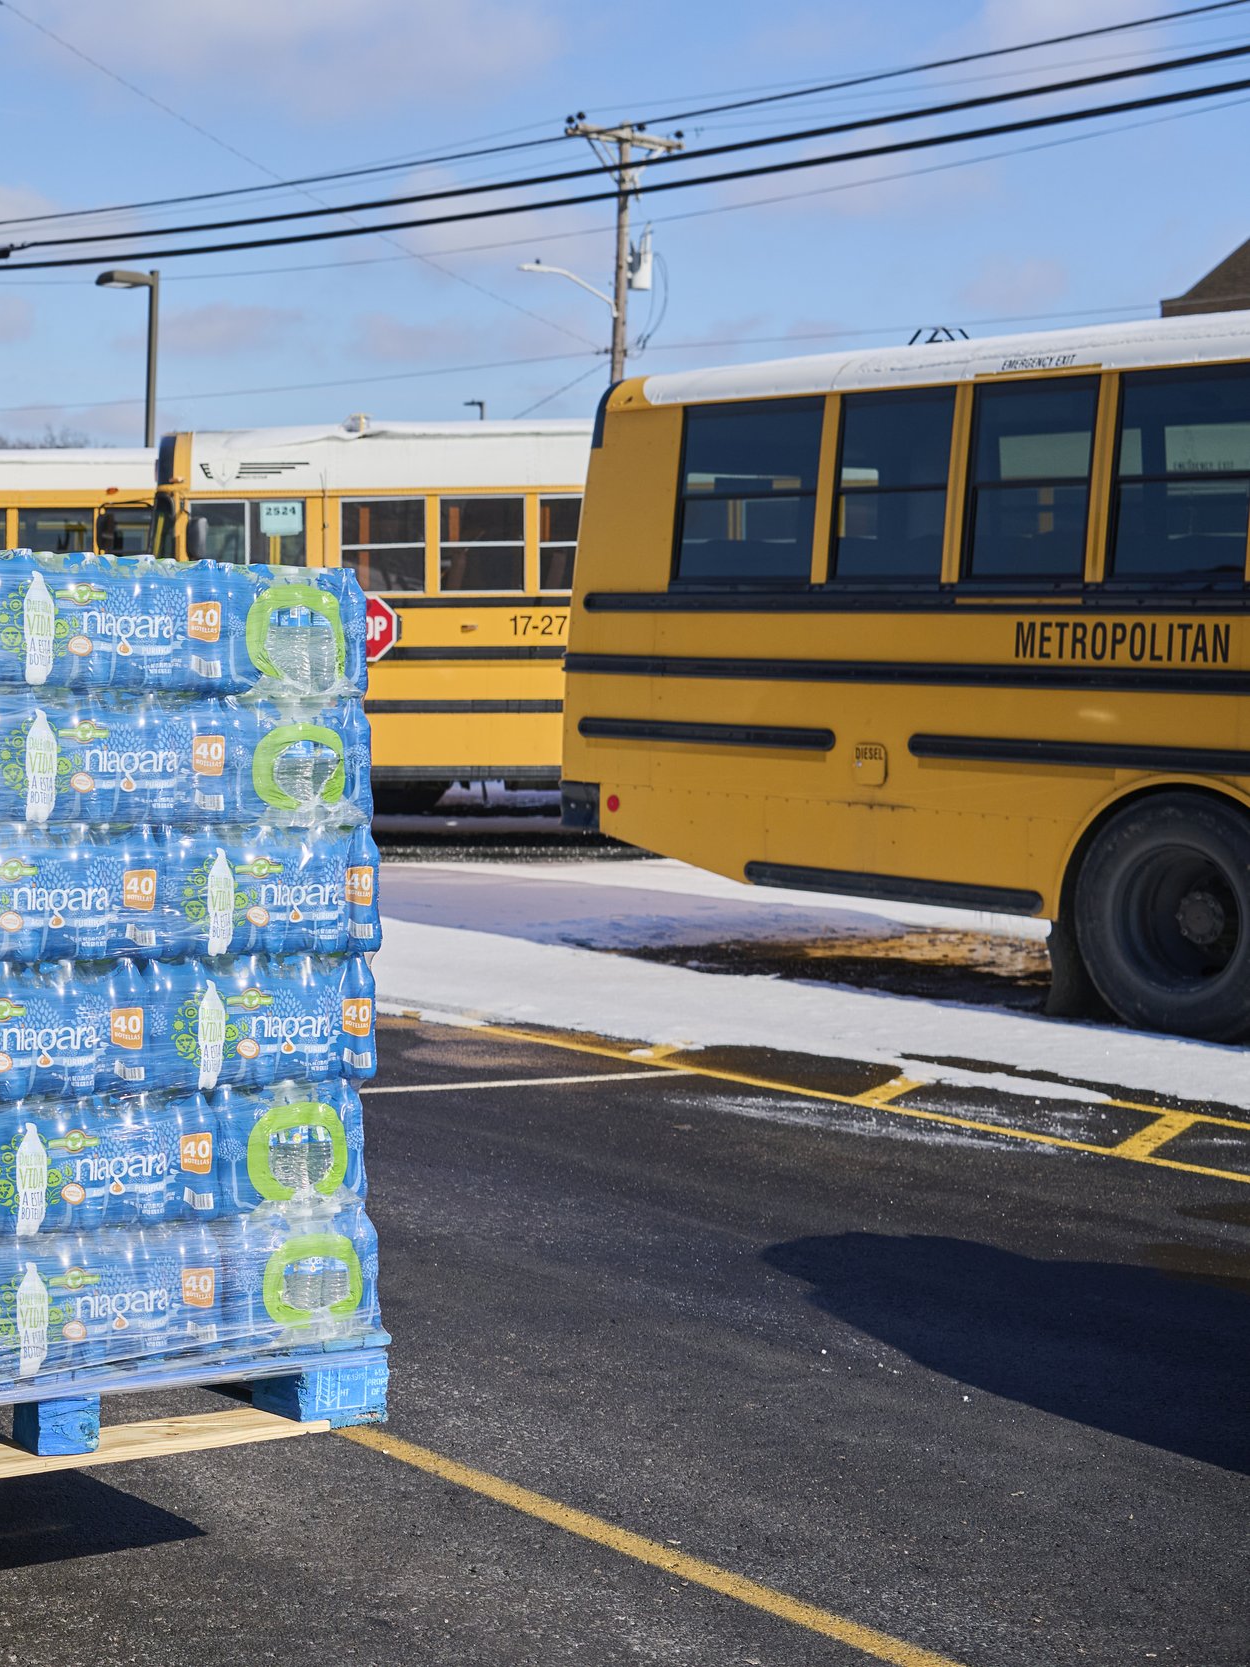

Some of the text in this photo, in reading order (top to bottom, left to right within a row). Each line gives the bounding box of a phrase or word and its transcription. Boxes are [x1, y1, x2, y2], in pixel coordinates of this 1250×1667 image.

[1001, 354, 1077, 370] EMERGENCY EXIT
[265, 506, 297, 516] 2524
[26, 614, 52, 636] VIDA
[191, 609, 219, 626] 40
[510, 615, 568, 635] 17-27
[82, 608, 174, 650] niagara
[366, 616, 388, 640] OP
[30, 637, 36, 652] A
[1014, 621, 1231, 663] METROPOLITAN
[195, 743, 223, 760] 40
[855, 747, 884, 760] DIESEL
[28, 752, 54, 774] VIDA
[85, 744, 178, 785] niagara
[32, 776, 38, 789] A
[126, 877, 153, 895] 40
[347, 873, 371, 890] 40
[13, 882, 110, 922] niagara
[213, 912, 219, 926] A
[345, 1005, 369, 1022] 40
[114, 1015, 141, 1034] 40
[200, 1022, 223, 1042] VIDA
[2, 1023, 97, 1061] niagara
[114, 1032, 140, 1041] BOTELLAS
[203, 1044, 209, 1058] A
[183, 1140, 210, 1158] 40
[19, 1167, 44, 1190] VIDA
[76, 1152, 168, 1190] niagara
[22, 1191, 43, 1206] A ESTA
[185, 1275, 212, 1293] 40
[76, 1288, 170, 1325] niagara
[19, 1306, 45, 1328] VIDA
[23, 1329, 30, 1344] A
